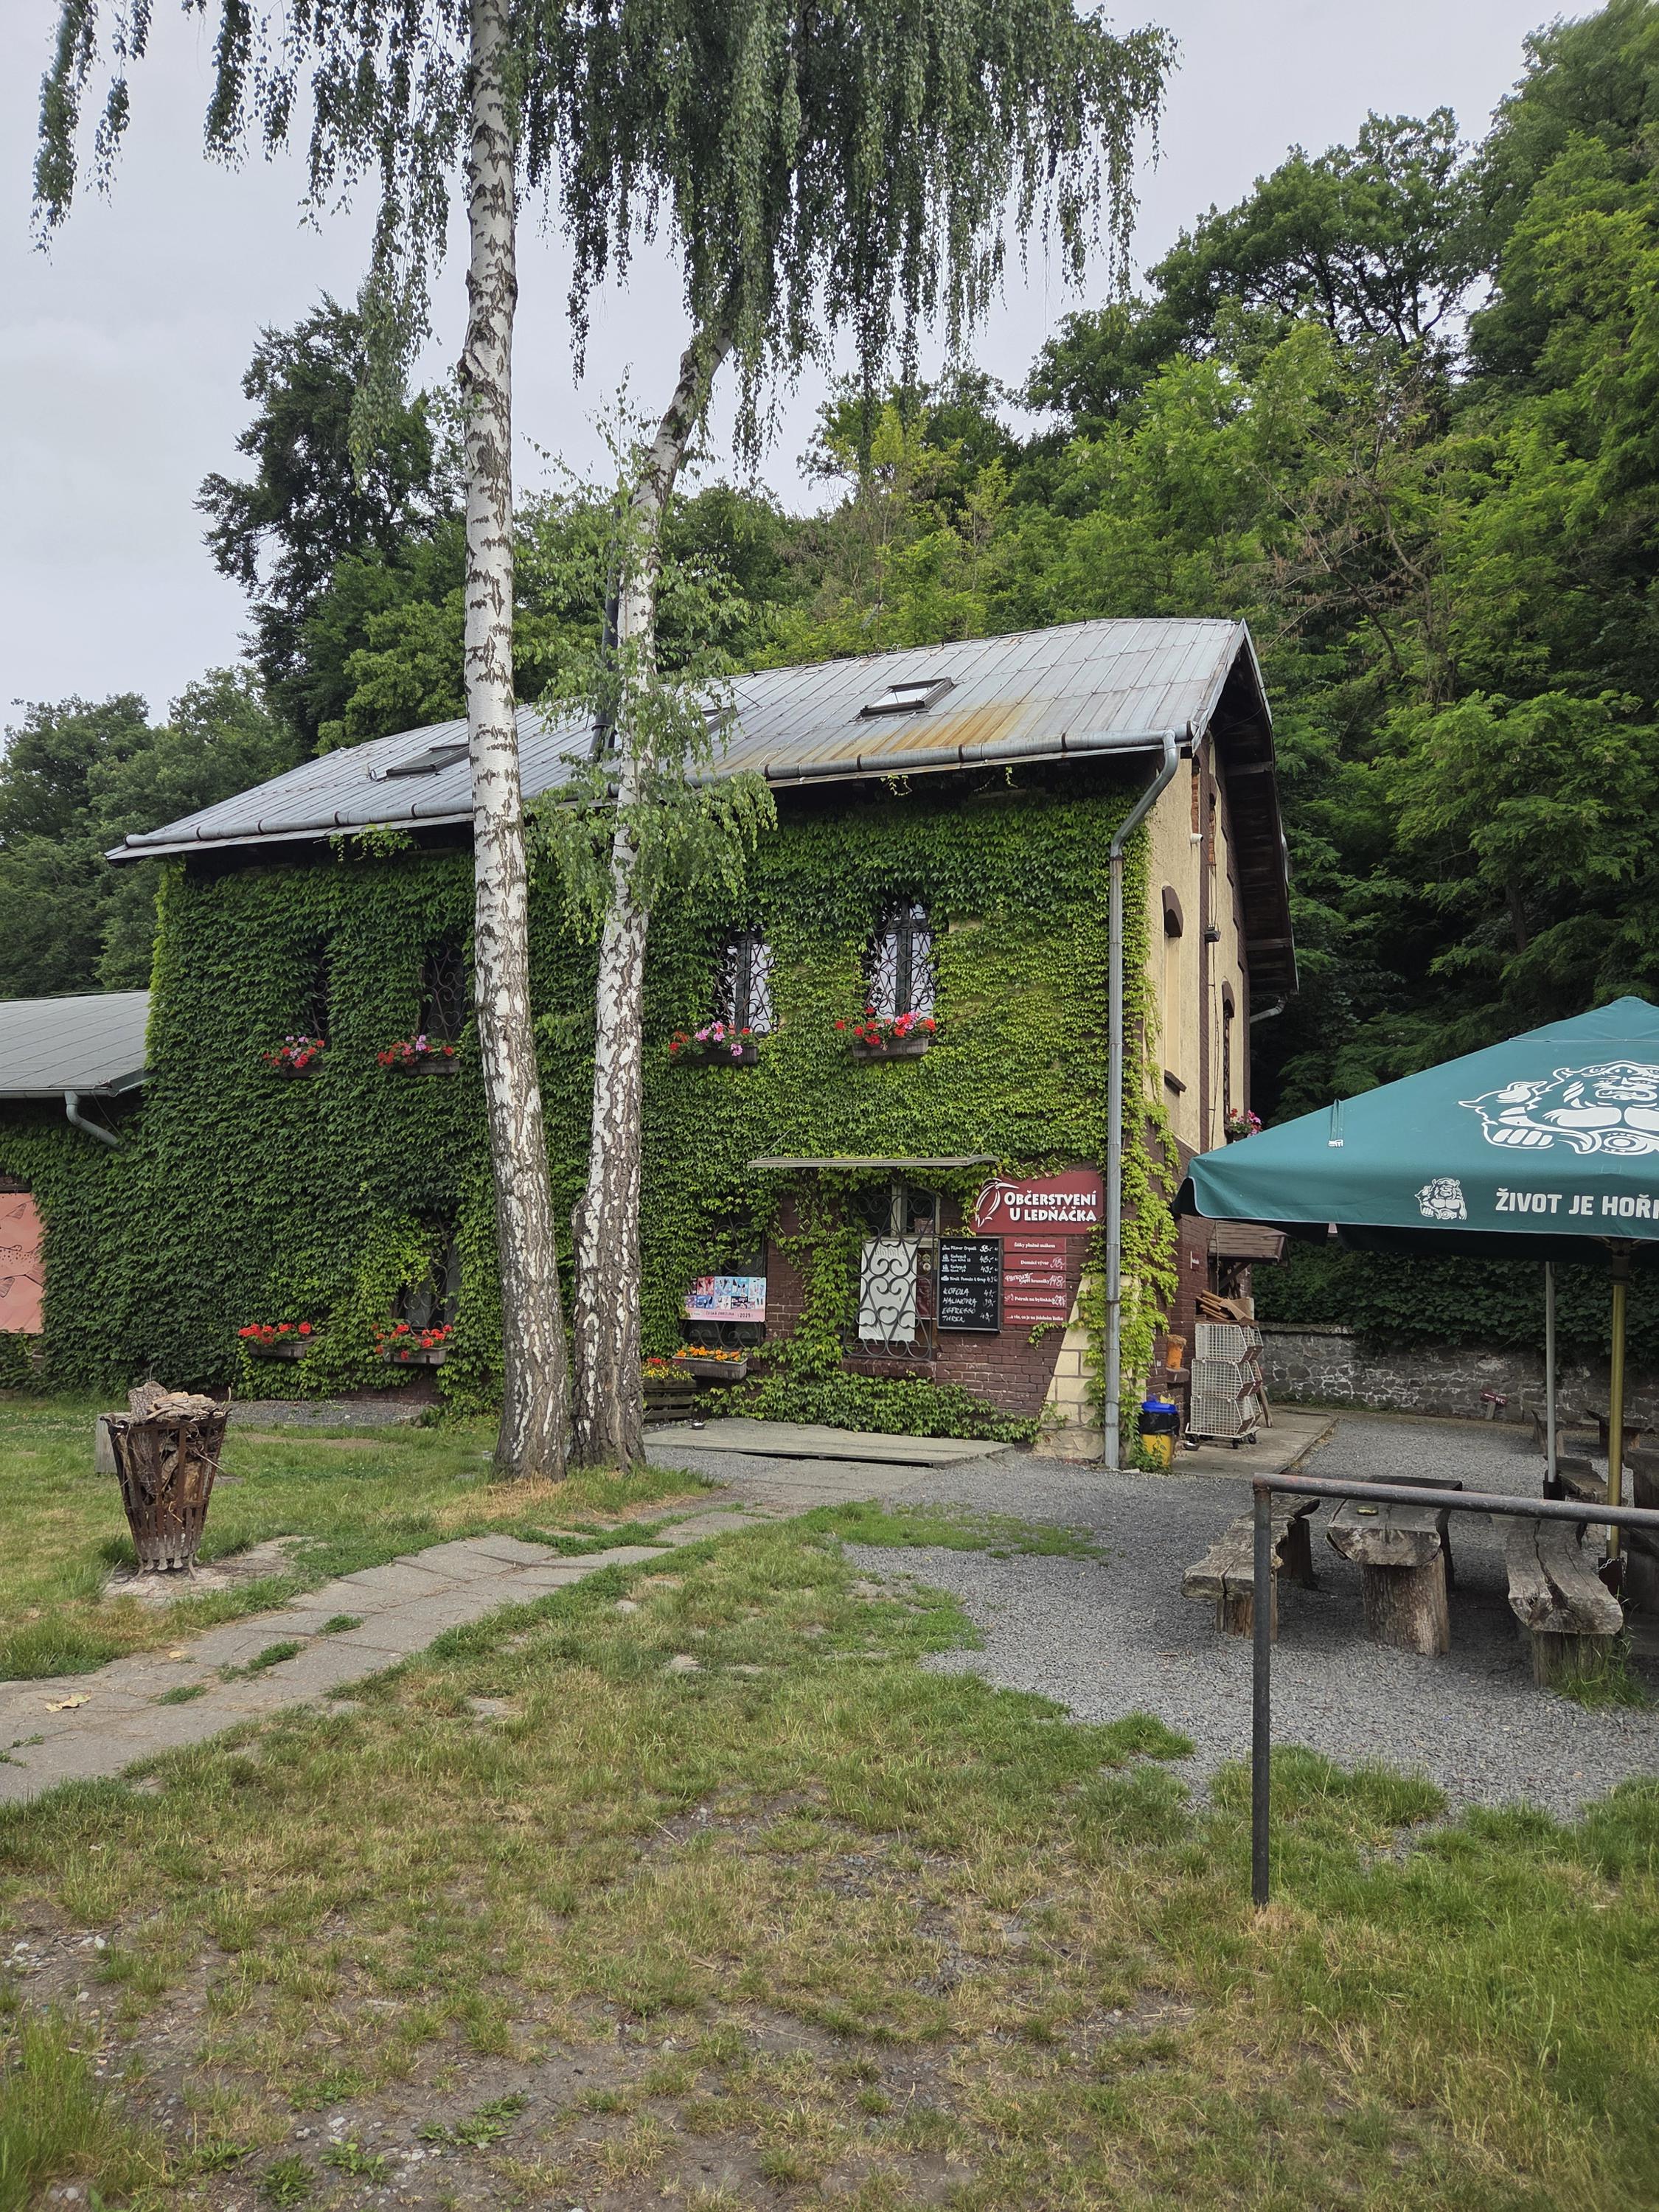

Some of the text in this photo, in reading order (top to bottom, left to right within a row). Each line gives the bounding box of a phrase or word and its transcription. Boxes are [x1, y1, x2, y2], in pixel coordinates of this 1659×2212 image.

[1004, 1190, 1097, 1206] OBČERSTVENÍ
[1495, 1187, 1562, 1214] ŽIVOT
[1568, 1195, 1594, 1215] JE
[1009, 1206, 1097, 1222] U LEDŇÁČKA
[943, 1287, 970, 1296] KOFOLA
